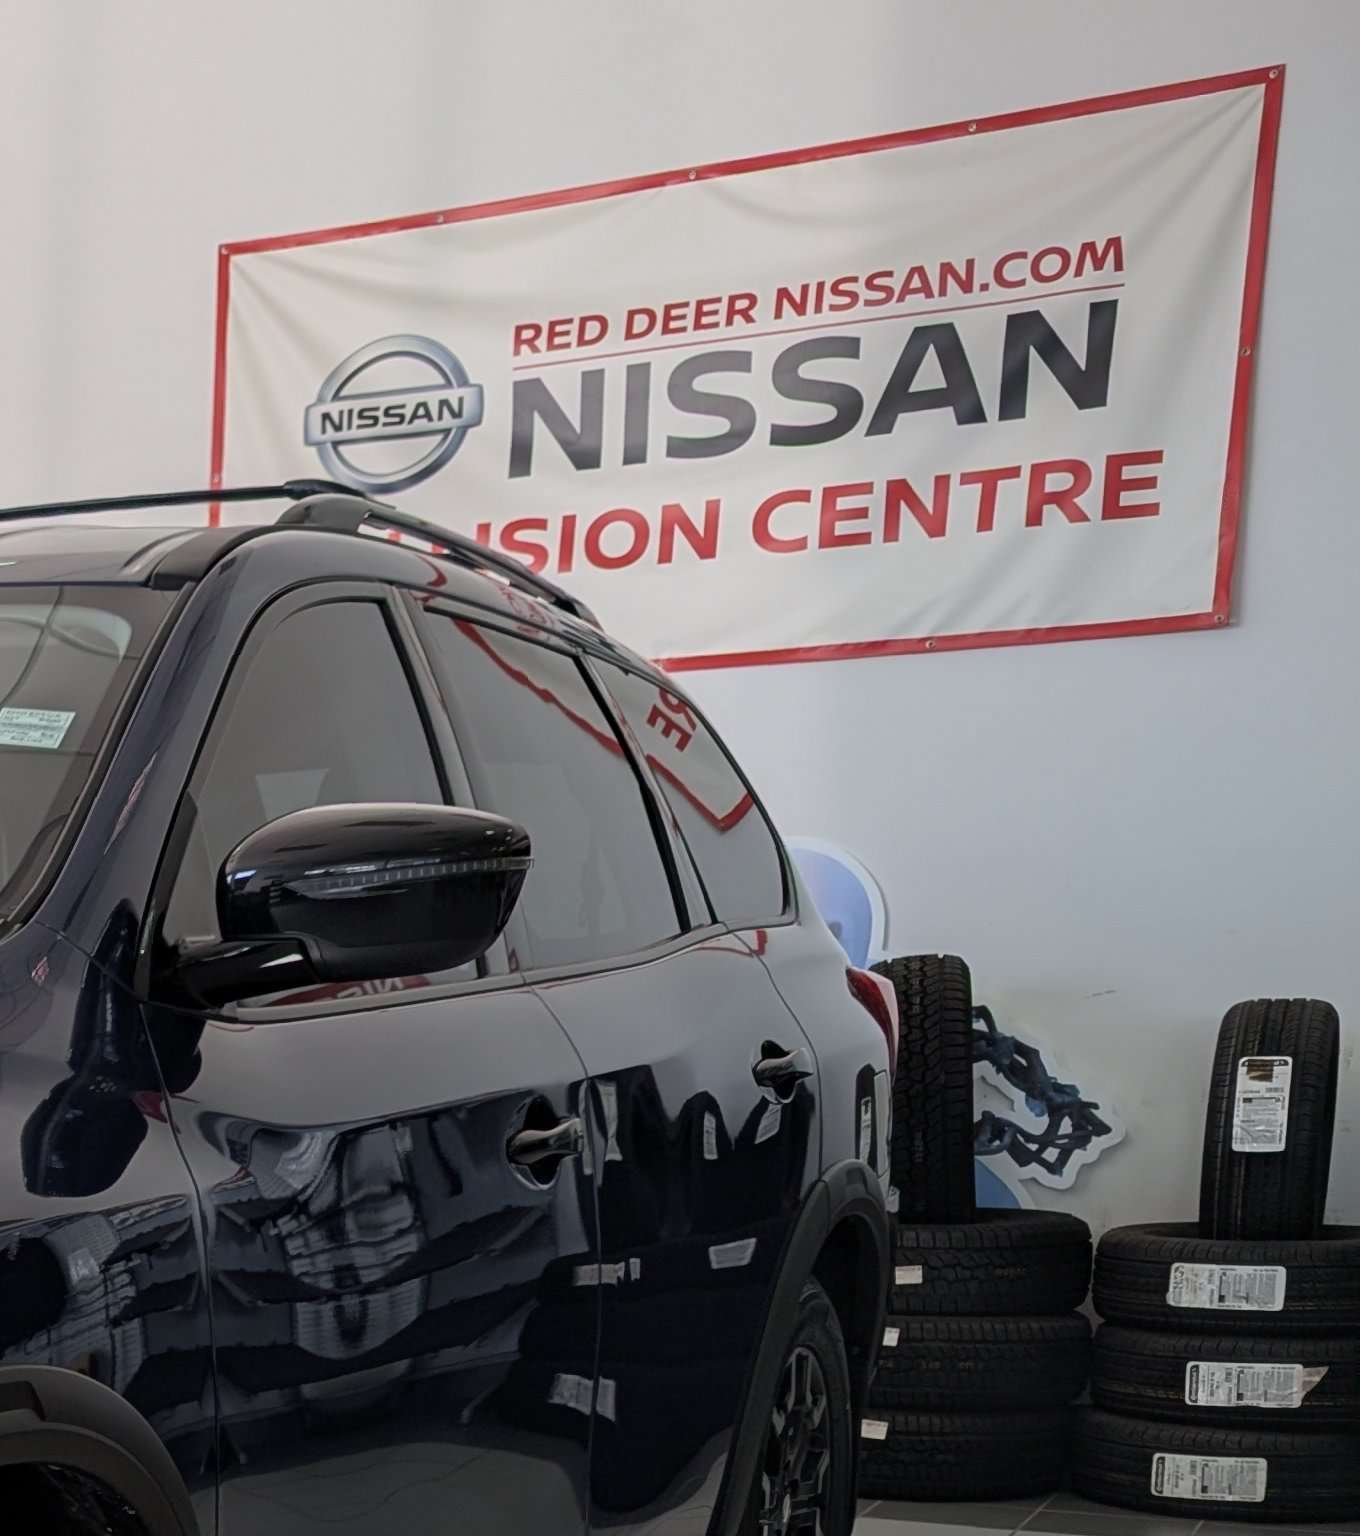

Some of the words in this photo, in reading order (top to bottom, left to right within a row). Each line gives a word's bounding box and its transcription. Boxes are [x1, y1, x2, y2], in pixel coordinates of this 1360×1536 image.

[513, 313, 609, 353] RED
[623, 292, 759, 342] DEER
[773, 235, 1125, 321] NISSAN.COM
[320, 396, 465, 435] NISSAN
[507, 299, 1119, 479] NISSAN
[752, 450, 1165, 554] CENTRE
